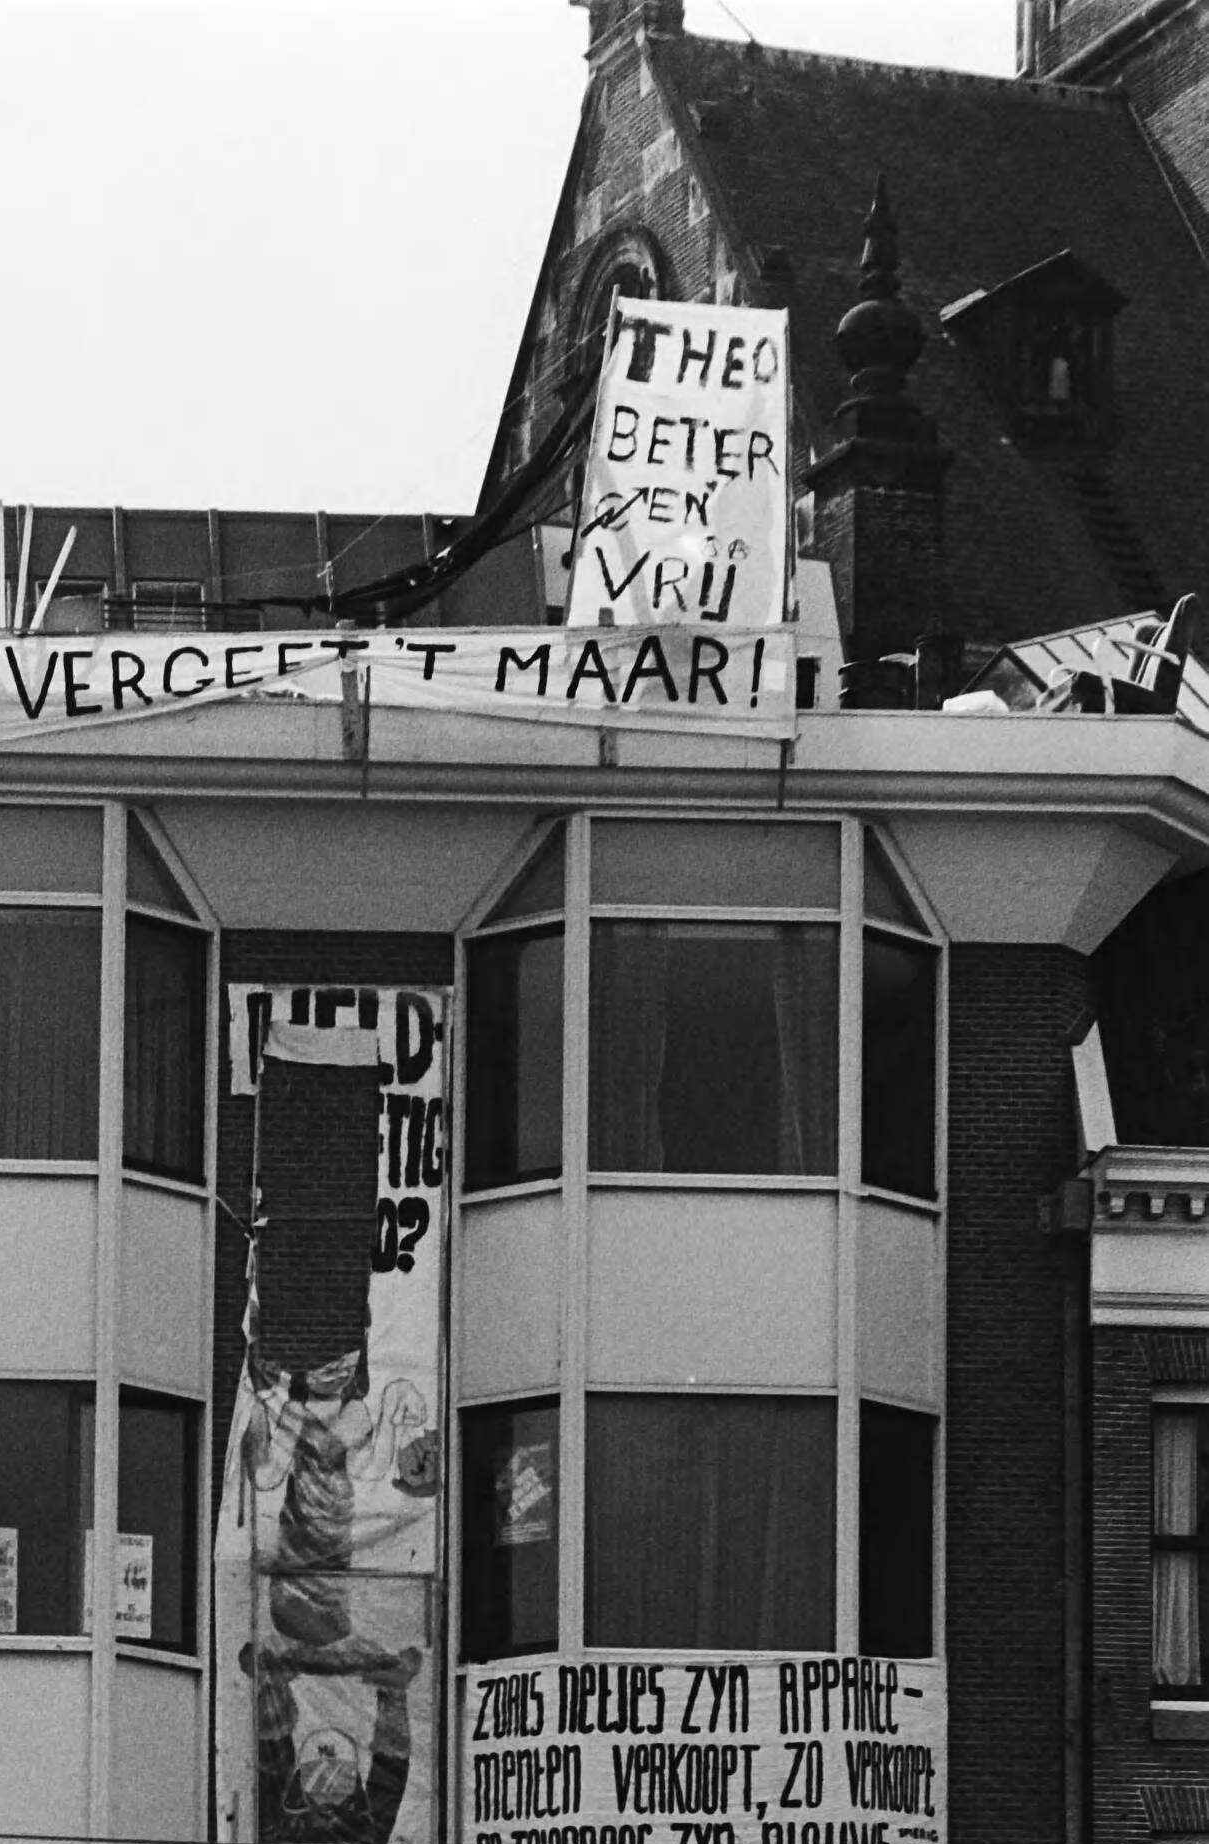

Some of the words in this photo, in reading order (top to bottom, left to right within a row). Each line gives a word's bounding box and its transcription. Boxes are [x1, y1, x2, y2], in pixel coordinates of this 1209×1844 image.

[620, 318, 778, 389] THEO
[607, 404, 779, 481] BETER
[495, 637, 769, 710] MAAR!
[472, 1670, 545, 1741] ZOALS
[779, 1741, 823, 1809] ZO
